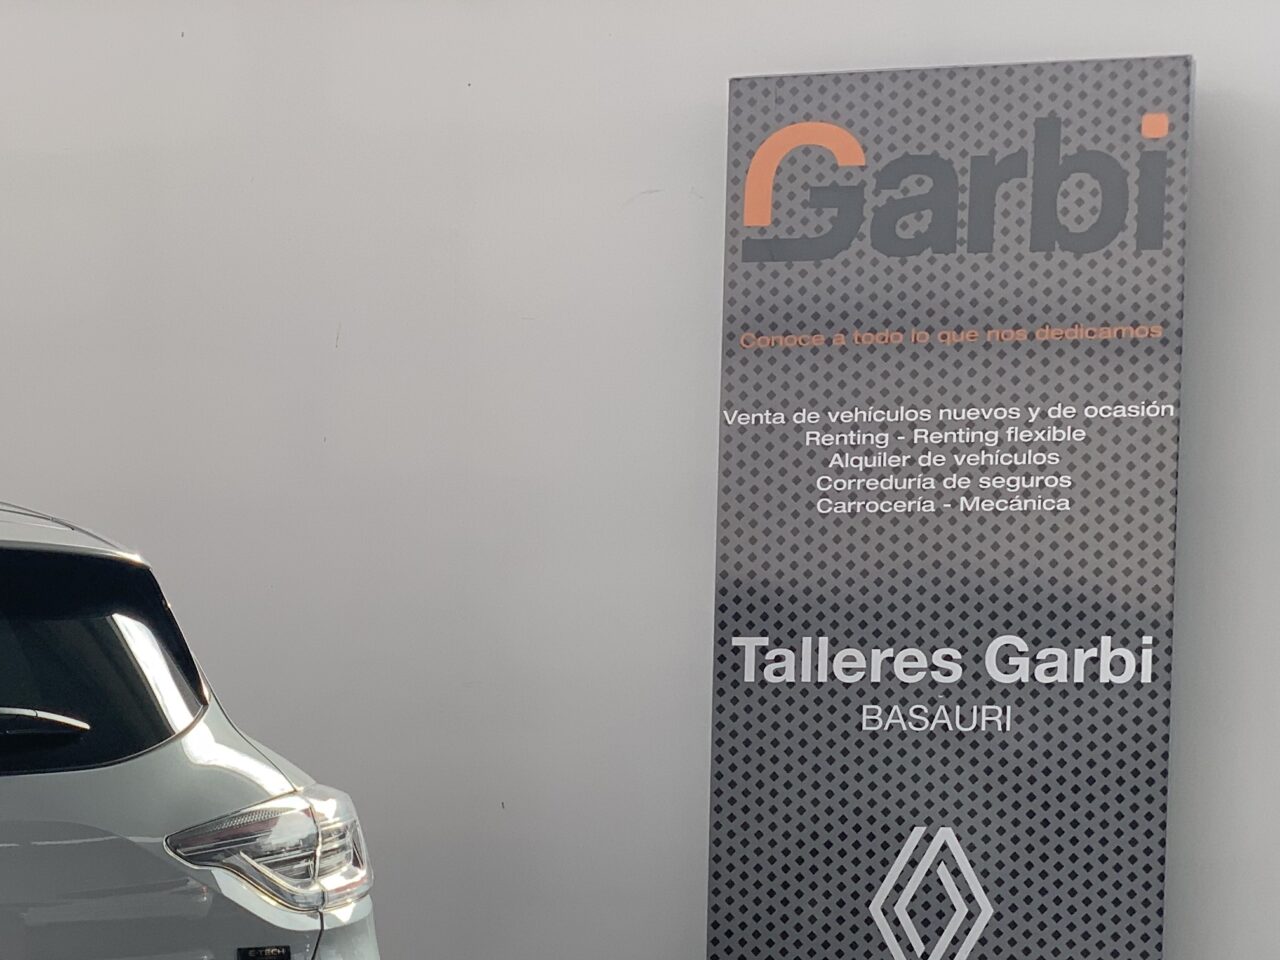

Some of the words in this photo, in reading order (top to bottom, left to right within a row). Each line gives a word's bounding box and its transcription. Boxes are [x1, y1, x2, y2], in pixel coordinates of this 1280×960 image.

[741, 112, 1169, 263] Garbi
[740, 332, 824, 349] Conoce
[832, 333, 846, 345] a
[853, 329, 903, 345] todo
[911, 329, 930, 344] lo
[937, 329, 978, 345] que
[986, 328, 1027, 341] nos
[1035, 324, 1163, 341] dedicamos
[723, 409, 786, 425] Venta
[792, 408, 820, 424] de
[827, 405, 932, 423] vehículos
[939, 406, 1020, 421] nuevos
[1027, 407, 1041, 423] y
[1047, 403, 1076, 419] de
[1084, 400, 1174, 418] ocasión
[805, 430, 889, 449] Renting
[913, 428, 999, 447] Renting
[1006, 425, 1087, 442] flexible
[828, 452, 911, 471] Alquiler
[918, 451, 946, 467] de
[953, 449, 1060, 466] vehículos
[816, 474, 936, 491] Correduría
[942, 473, 971, 489] de
[978, 475, 1072, 492] seguros
[816, 497, 936, 514] Carrocería
[959, 495, 1070, 512] Mecánica
[732, 636, 963, 684] Talleres
[985, 634, 1153, 684] Garbi
[861, 704, 1012, 732] BASAURI
